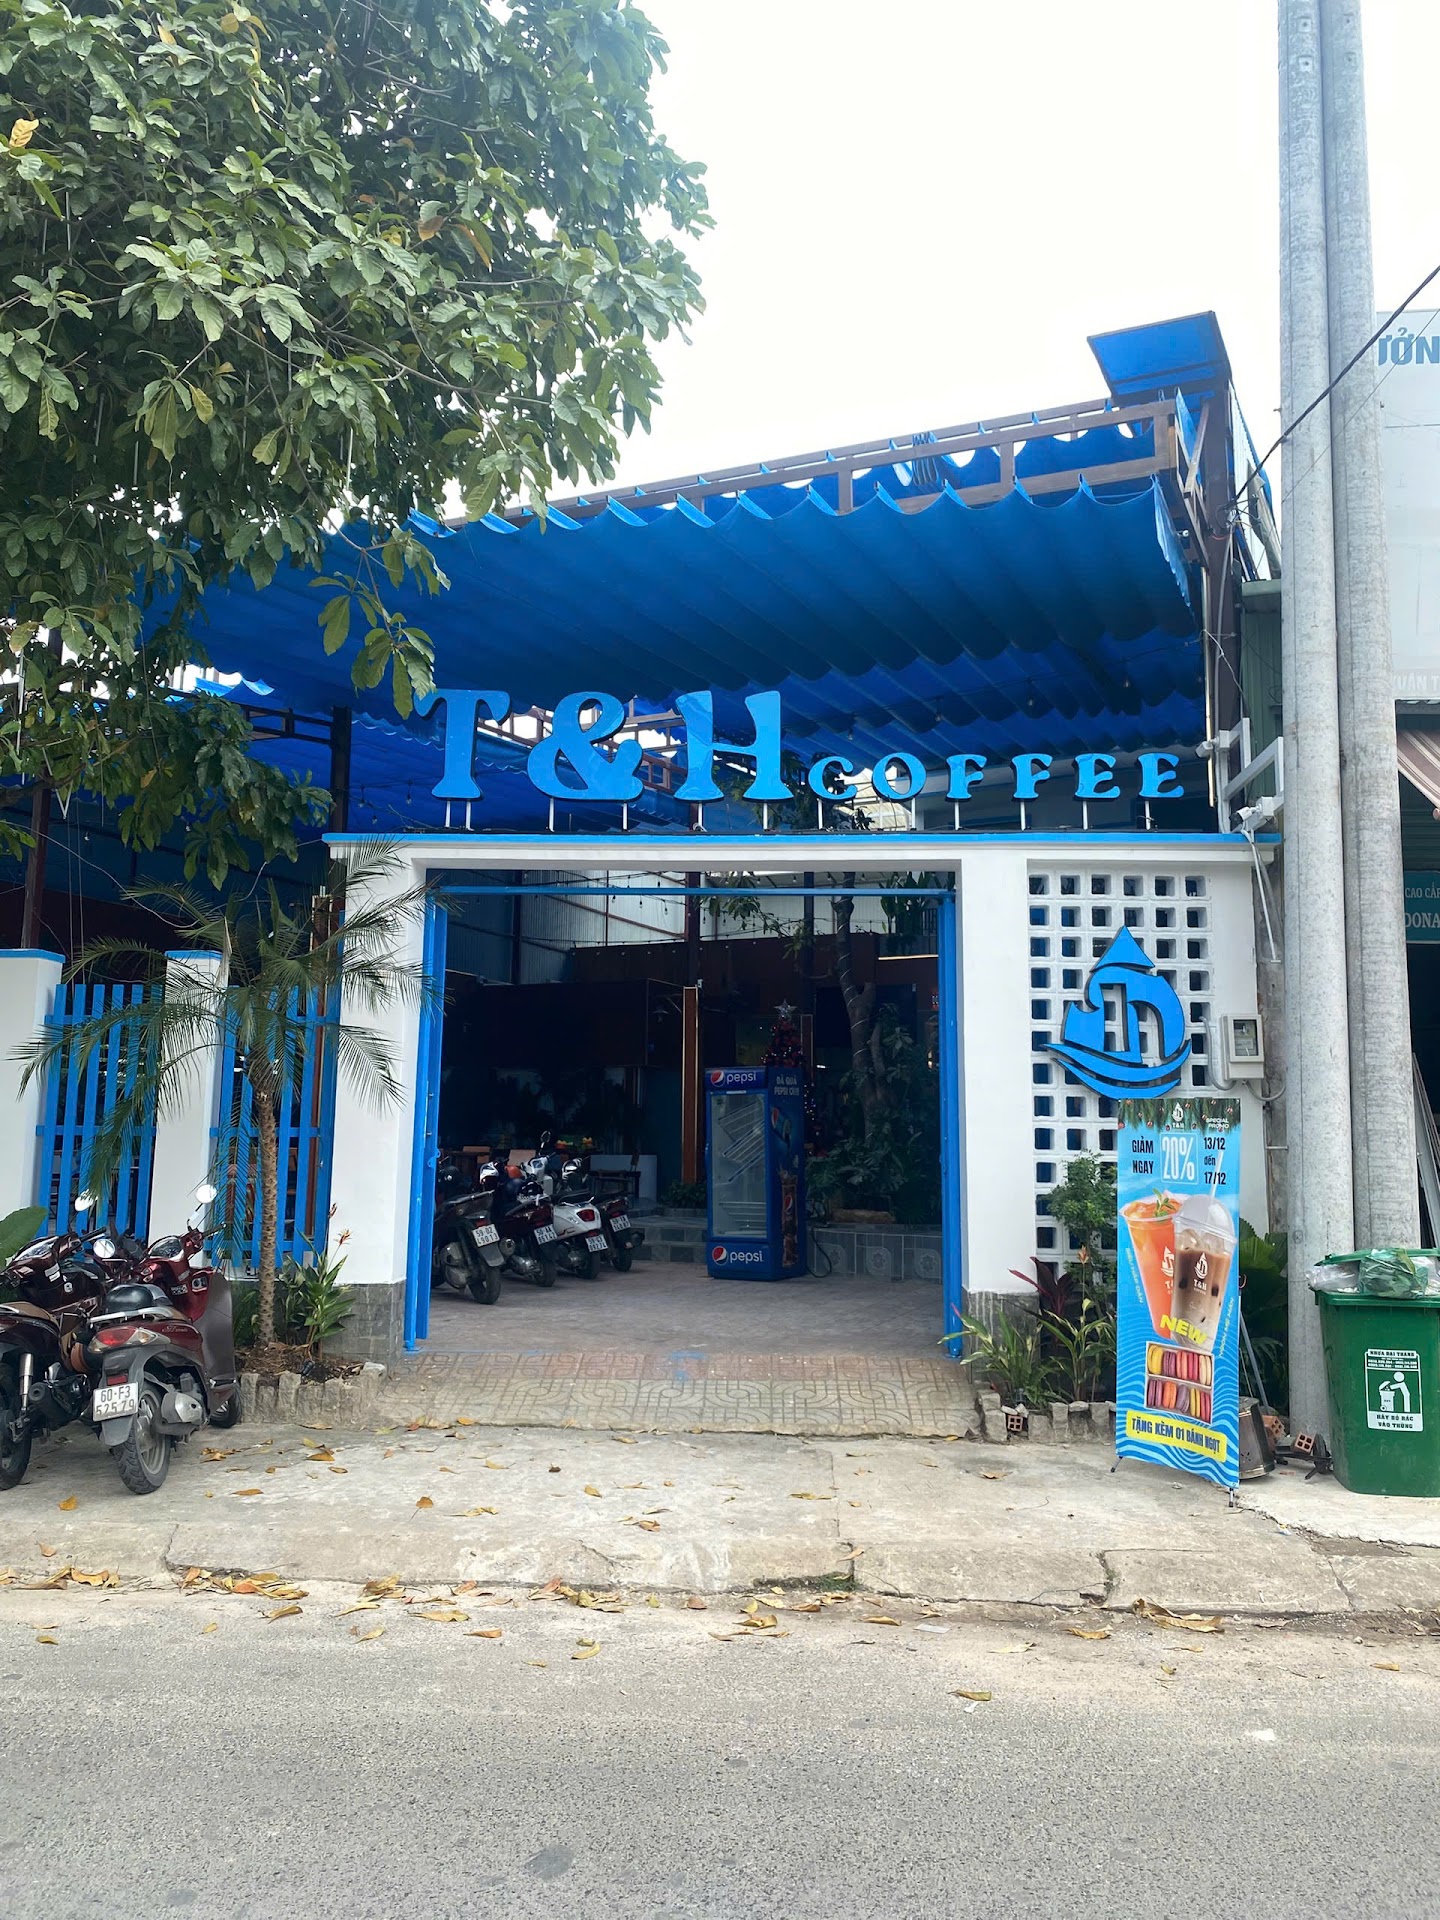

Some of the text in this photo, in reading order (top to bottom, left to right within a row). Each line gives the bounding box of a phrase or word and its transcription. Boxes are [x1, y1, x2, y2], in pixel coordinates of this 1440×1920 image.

[415, 690, 1184, 800] T&H COFFEE
[1404, 887, 1423, 898] CAO
[726, 1071, 757, 1084] pepsi
[1132, 1136, 1154, 1154] GIẢM
[1204, 1137, 1226, 1150] 13/12
[1162, 1136, 1195, 1181] 20%
[1204, 1154, 1216, 1166] đến
[1132, 1160, 1154, 1174] NGAY
[1204, 1172, 1226, 1184] 17/12
[730, 1250, 763, 1264] pepsi
[1160, 1314, 1207, 1344] NEW
[1132, 1416, 1152, 1434] TẶNG
[1154, 1421, 1173, 1438] KÈM
[1176, 1428, 1184, 1440] 01
[1186, 1428, 1204, 1446] BÁNH
